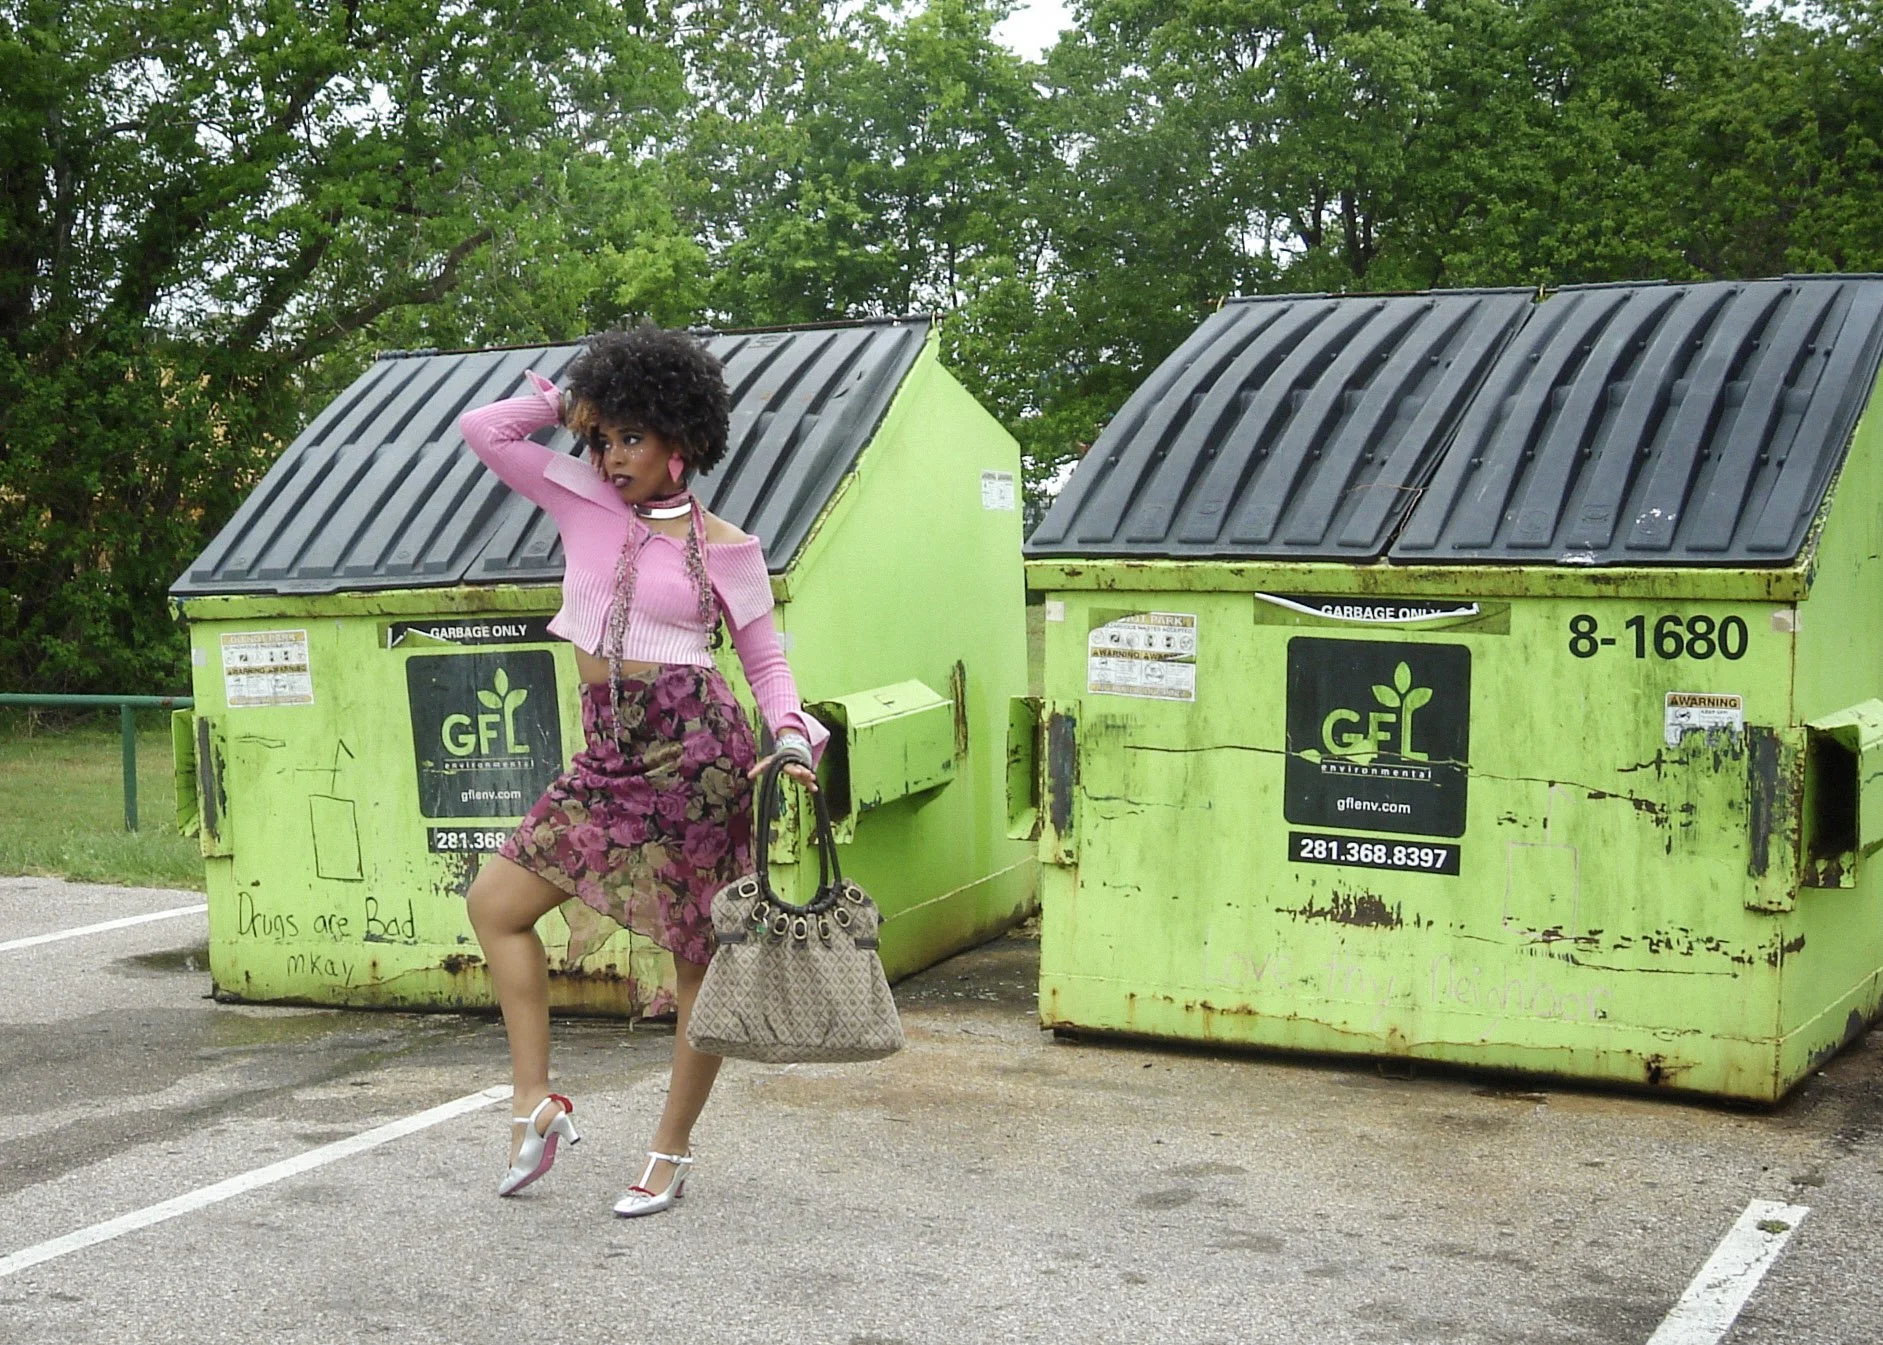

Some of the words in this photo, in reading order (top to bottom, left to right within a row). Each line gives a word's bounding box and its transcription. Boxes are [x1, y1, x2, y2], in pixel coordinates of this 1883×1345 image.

[1321, 604, 1395, 620] GARBAGE
[1151, 616, 1182, 626] PARK
[430, 625, 490, 640] GARBAGE
[492, 624, 527, 638] ONLY
[1569, 614, 1748, 660] 8-1680
[1679, 695, 1738, 708] WARNING
[441, 698, 530, 757] GFL
[1321, 697, 1429, 761] GFL
[444, 759, 534, 769] environmental
[1321, 763, 1432, 779] environmental
[461, 789, 521, 802] gflenv.com
[1336, 797, 1411, 814] gflenv.com
[1300, 838, 1447, 869] 281.368.8397
[238, 891, 299, 939] Drugs
[314, 914, 352, 938] are
[365, 896, 415, 938] Bad
